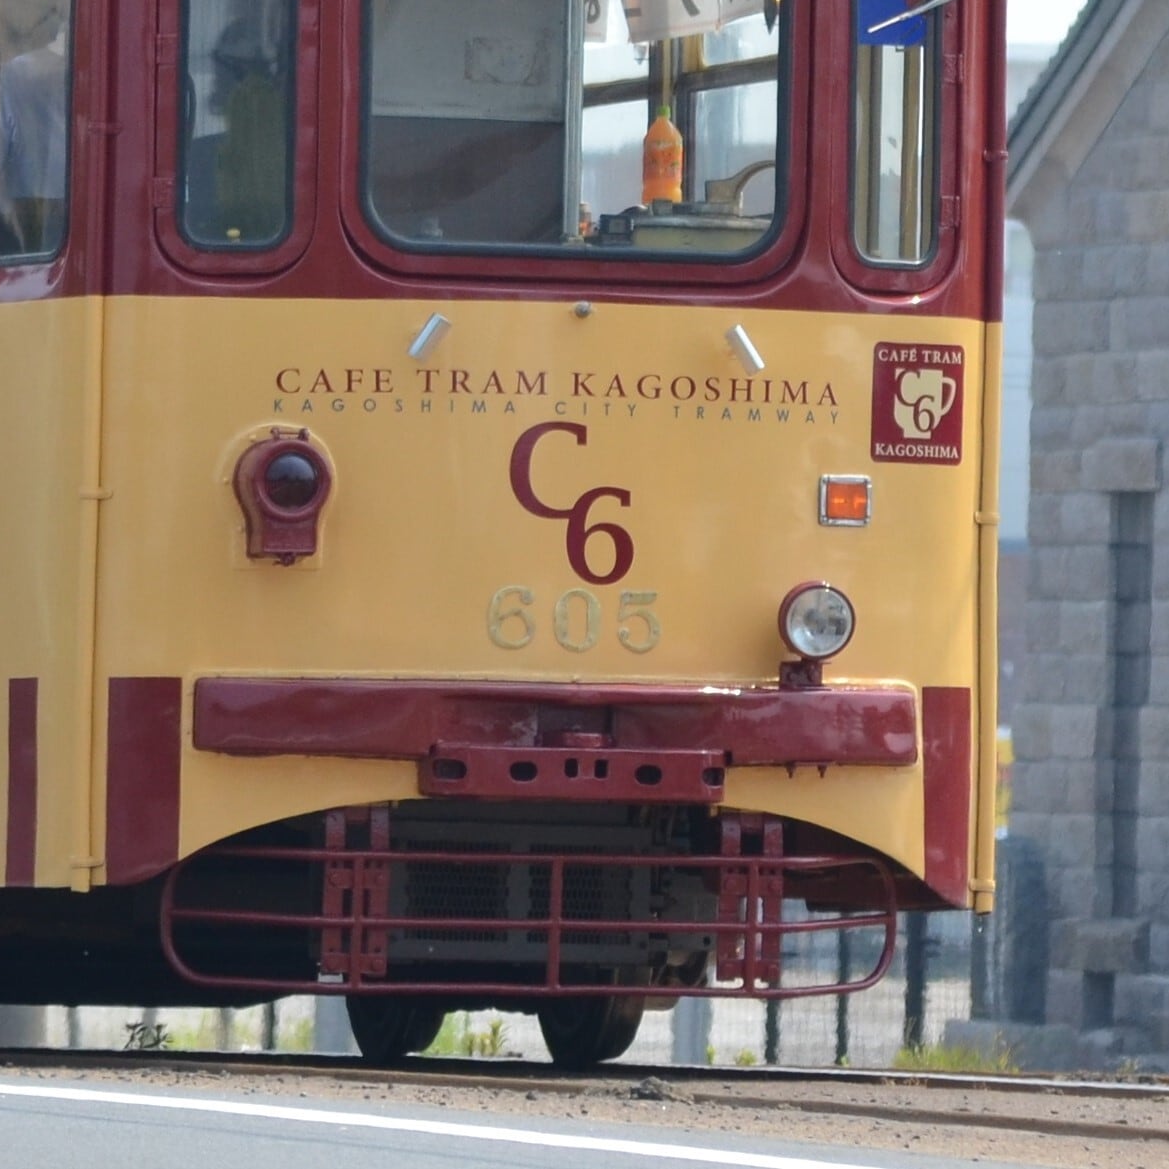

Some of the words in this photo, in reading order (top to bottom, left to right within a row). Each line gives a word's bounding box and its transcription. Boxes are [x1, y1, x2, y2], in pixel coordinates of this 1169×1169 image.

[878, 348, 917, 362] CAFÉ
[922, 350, 962, 365] TRAM
[275, 368, 395, 395] CAFE
[415, 369, 548, 397] TRAM
[572, 372, 840, 408] KAGOSHIMA
[274, 398, 517, 415] KAGOSHIMA
[554, 401, 638, 417] CITY
[673, 405, 840, 425] TRAMWAY
[874, 443, 959, 459] KAGOSHIMA
[508, 421, 635, 585] C6
[486, 584, 662, 654] 605
